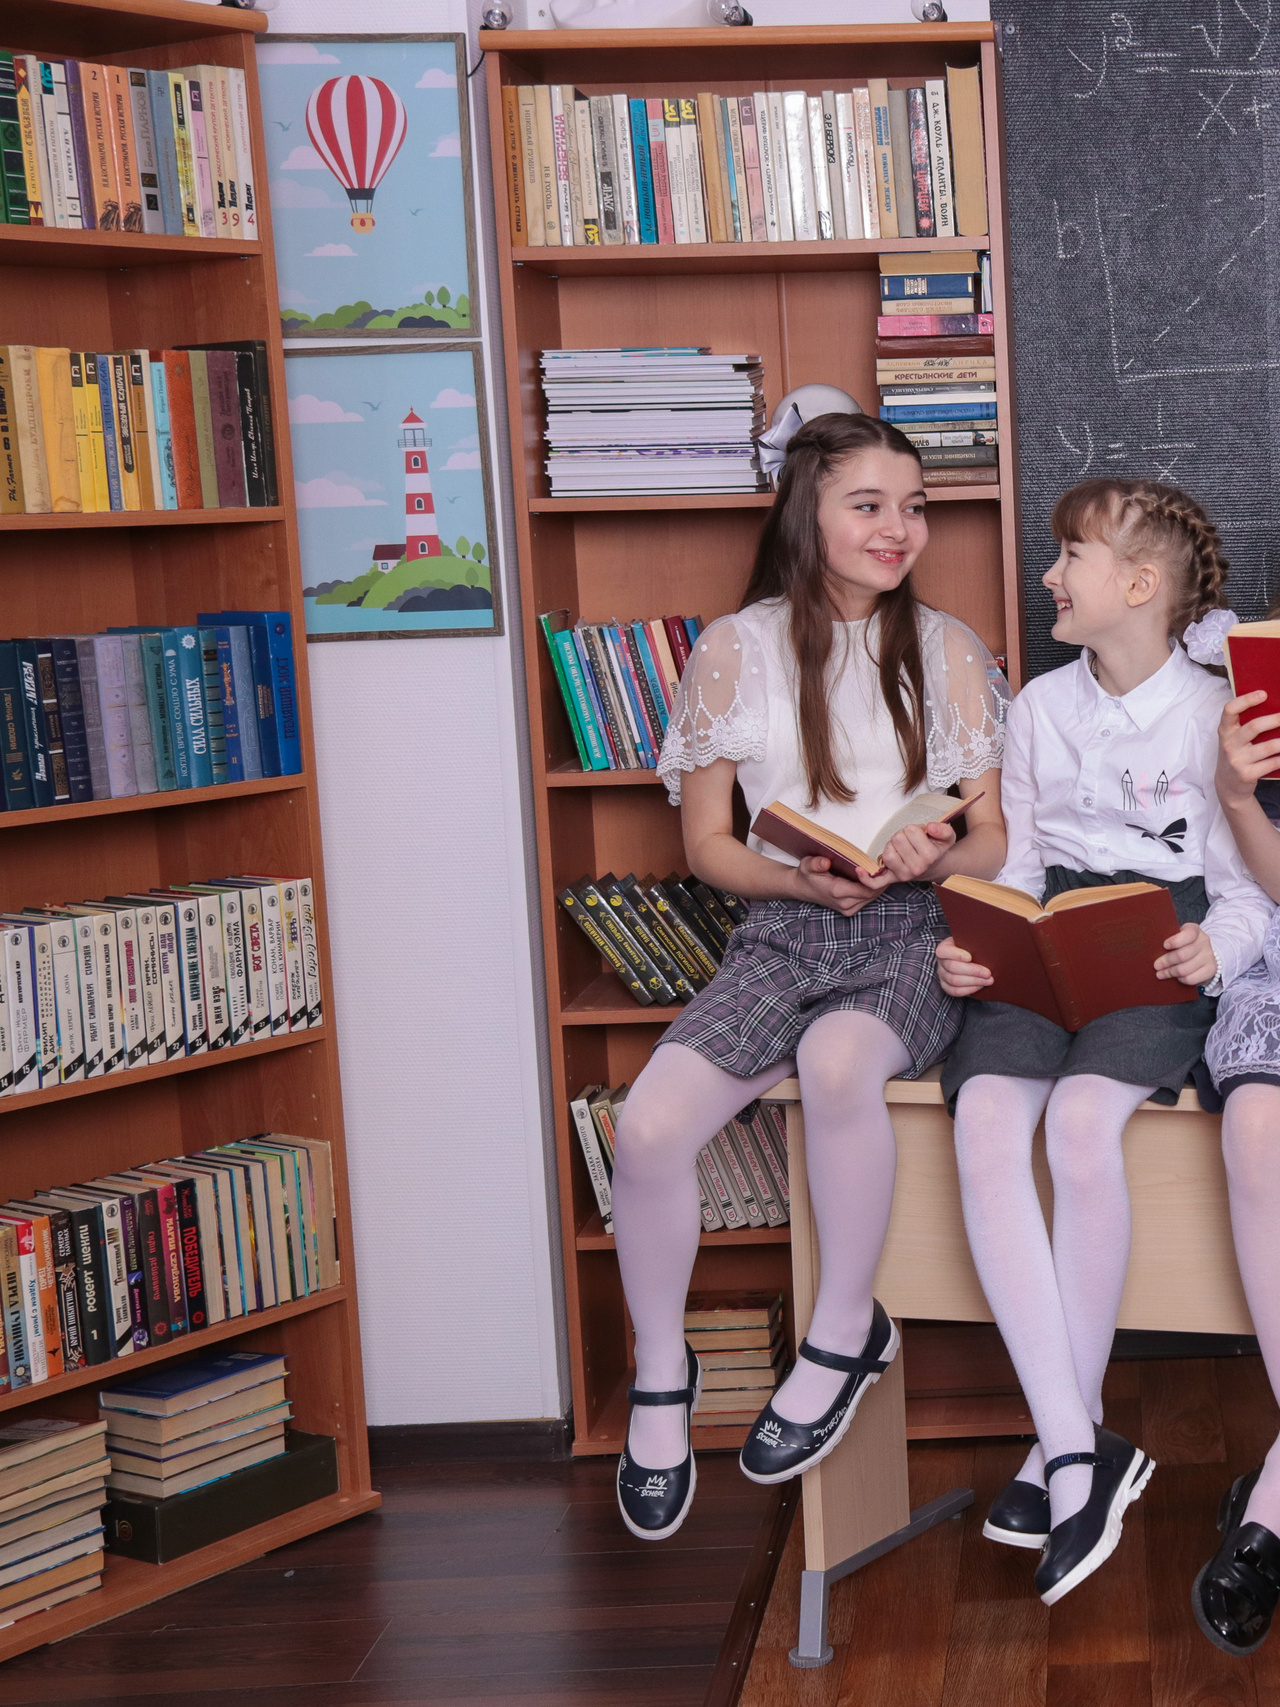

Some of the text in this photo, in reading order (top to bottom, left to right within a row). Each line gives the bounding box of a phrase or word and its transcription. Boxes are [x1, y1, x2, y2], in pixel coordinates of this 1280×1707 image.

[92, 71, 97, 81] 2
[116, 74, 120, 84] 1
[92, 91, 102, 117] ИСТОРИЯ
[116, 94, 125, 118] ИСТОРИЯ
[208, 81, 217, 111] ДЕТЕКТИВ
[220, 80, 228, 107] ДЕТЕКТИВ
[554, 114, 569, 181] ВЕНЕРИАНА
[527, 148, 536, 184] ГУМИЛЕВ
[619, 117, 634, 216] Джером Клапка Джером
[883, 186, 892, 213] АЙЗЕК
[917, 171, 930, 211] ЦИРЦЕИ
[221, 211, 228, 225] 3
[231, 213, 240, 227] 9
[246, 213, 255, 225] 4
[894, 371, 978, 381] КРЕСТЬЯНСКИЕ ДЕТИ
[23, 368, 38, 446] БУДДЕНБРОКИ
[168, 659, 177, 677] УМА
[4, 693, 14, 721] ЛЕОНИД
[172, 688, 182, 720] СОШЛО
[276, 657, 296, 739] ГРЕМЯЩИЙ МОСТ
[563, 642, 601, 758] ЖИЛИЩНОЕ ЗАКОНОДАТЕЛЬСТВО РОССИИ
[651, 677, 667, 716] АЛГЕБРА
[186, 677, 207, 754] СИЛА СИЛЬНЫХ
[176, 722, 185, 749] ВРЕМЯ
[179, 750, 188, 777] КОГДА
[249, 922, 262, 972] БОГ СВЕТА
[275, 921, 284, 973] ИЗ КИММЕРИИ
[583, 921, 622, 967] Владимир МИХАЙЛОВ
[605, 919, 641, 964] Владимир САВЧЕНКО
[634, 925, 651, 944] ПАВЛОВ
[148, 932, 158, 985] СОМКНИСЬ!
[162, 951, 170, 974] ПОЧТИ
[232, 921, 243, 978] ФАРНХЭМА
[270, 946, 278, 974] КОНАН,
[674, 949, 696, 974] ЛОГИНОВ
[86, 983, 98, 1042] РОБЕРТ СИЛЬВЕРБЕРГ
[213, 1005, 224, 1024] ДЖЕК
[311, 1008, 320, 1018] 30
[21, 1007, 30, 1053] ФАРМЕР
[68, 1033, 76, 1054] ФРЭНК
[153, 1038, 161, 1048] 21
[195, 1038, 203, 1047] 23
[218, 1037, 225, 1046] 24
[134, 1047, 142, 1056] 20
[172, 1042, 180, 1051] 22
[22, 1065, 30, 1075] 15
[70, 1063, 79, 1071] 17
[111, 1057, 119, 1066] 19
[579, 1125, 599, 1182] ЗАГАДКА РУННОГО
[595, 1156, 606, 1180] ПОСОХА
[702, 1153, 726, 1197] МИРЫ ГАРРИ
[724, 1149, 749, 1193] МИРЫ ГАРРИ
[746, 1150, 769, 1195] МИРЫ ГАРРИ
[766, 1153, 790, 1196] МИРЫ ГАРРИ
[599, 1190, 607, 1206] МАЙКЛ
[603, 1187, 611, 1206] МУРКОК
[728, 1210, 735, 1219] 5
[58, 1230, 66, 1257] СЕМЕРО
[63, 1228, 71, 1257] ТАЙНЫХ
[42, 1227, 54, 1289] ЧЕРНОКНИЖНИК
[165, 1217, 182, 1303] МАРИЯ СЕМЁНОВА
[183, 1226, 202, 1297] ПОБЕДИТЕЛЬ
[39, 1267, 47, 1290] ГОРЕЦ
[27, 1278, 38, 1307] Худеем
[31, 1314, 41, 1337] умом!
[64, 1291, 79, 1346] ЮРИЙ НИКИТИН
[90, 1329, 98, 1340] 1
